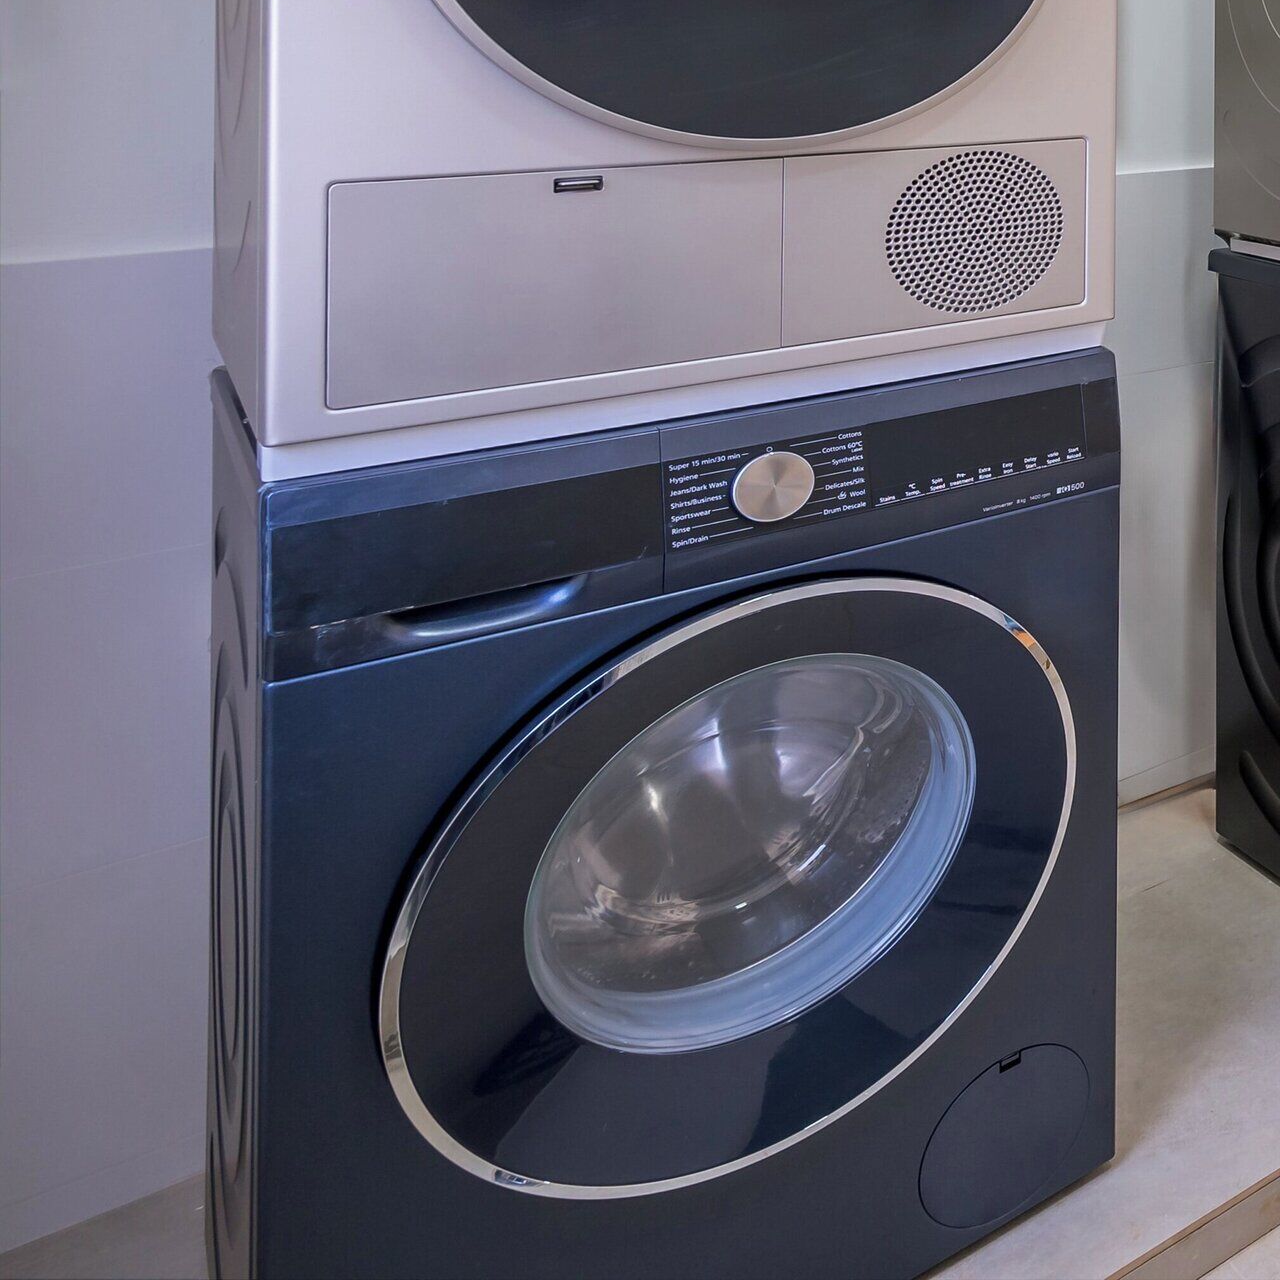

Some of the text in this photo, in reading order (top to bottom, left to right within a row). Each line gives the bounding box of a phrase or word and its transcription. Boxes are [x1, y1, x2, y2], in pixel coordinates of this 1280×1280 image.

[838, 432, 862, 440] Cottons
[822, 445, 846, 454] Cottons
[832, 455, 864, 466] Synthetics
[669, 463, 689, 471] Super
[670, 474, 699, 484] Hygiene
[670, 481, 728, 497] Jeans/Dark Wash
[670, 494, 722, 510] Shirts/Business
[824, 501, 866, 515] Drum Descale
[671, 510, 711, 523] Sportswear
[672, 527, 691, 535] Rinse
[672, 536, 708, 548] Spin/Drain
